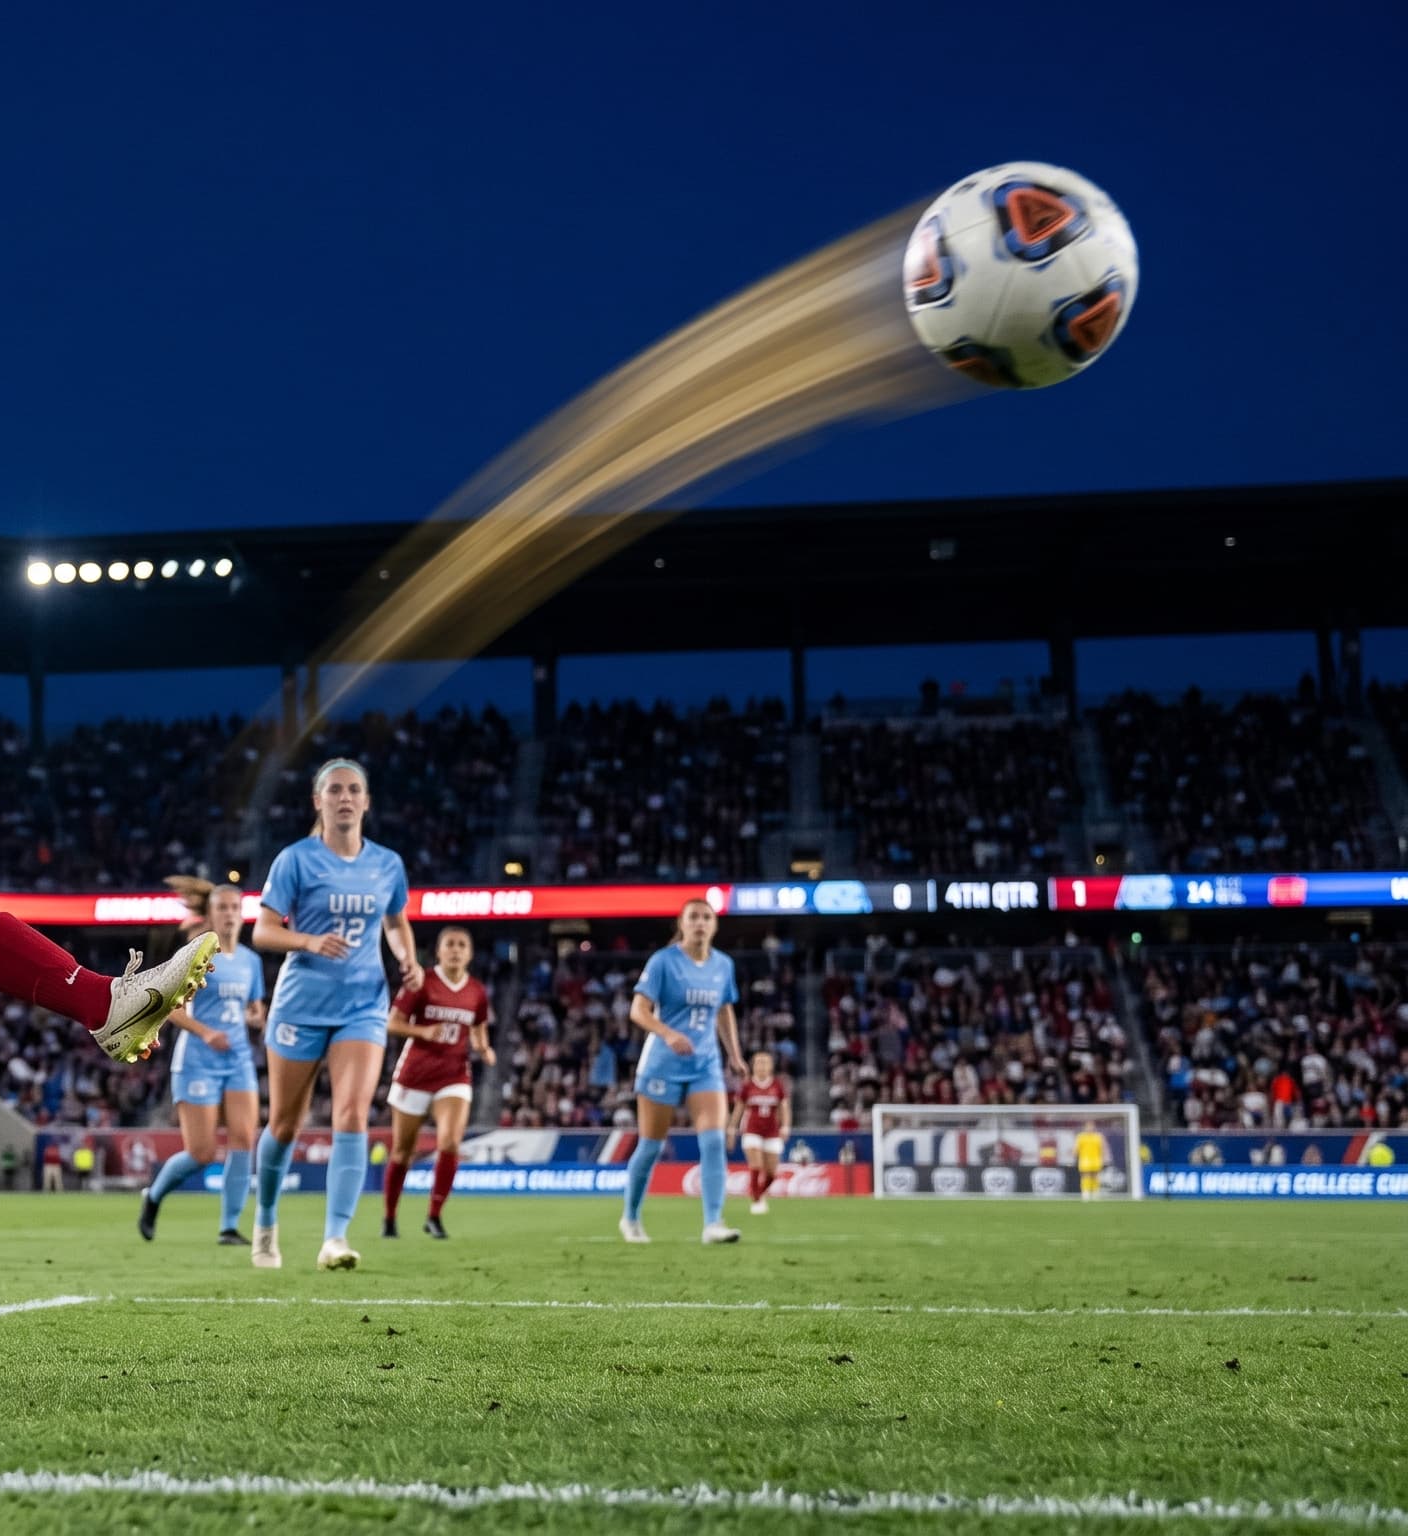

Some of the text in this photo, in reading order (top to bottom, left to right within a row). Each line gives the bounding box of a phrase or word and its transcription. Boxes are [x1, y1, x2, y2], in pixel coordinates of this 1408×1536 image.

[329, 893, 376, 914] UNC
[893, 883, 912, 910] 0
[945, 881, 1039, 912] 4TH QTR
[1071, 880, 1087, 907] 1
[1200, 1171, 1293, 1195] WOMEN'S
[1293, 1172, 1374, 1195] COLLEGE
